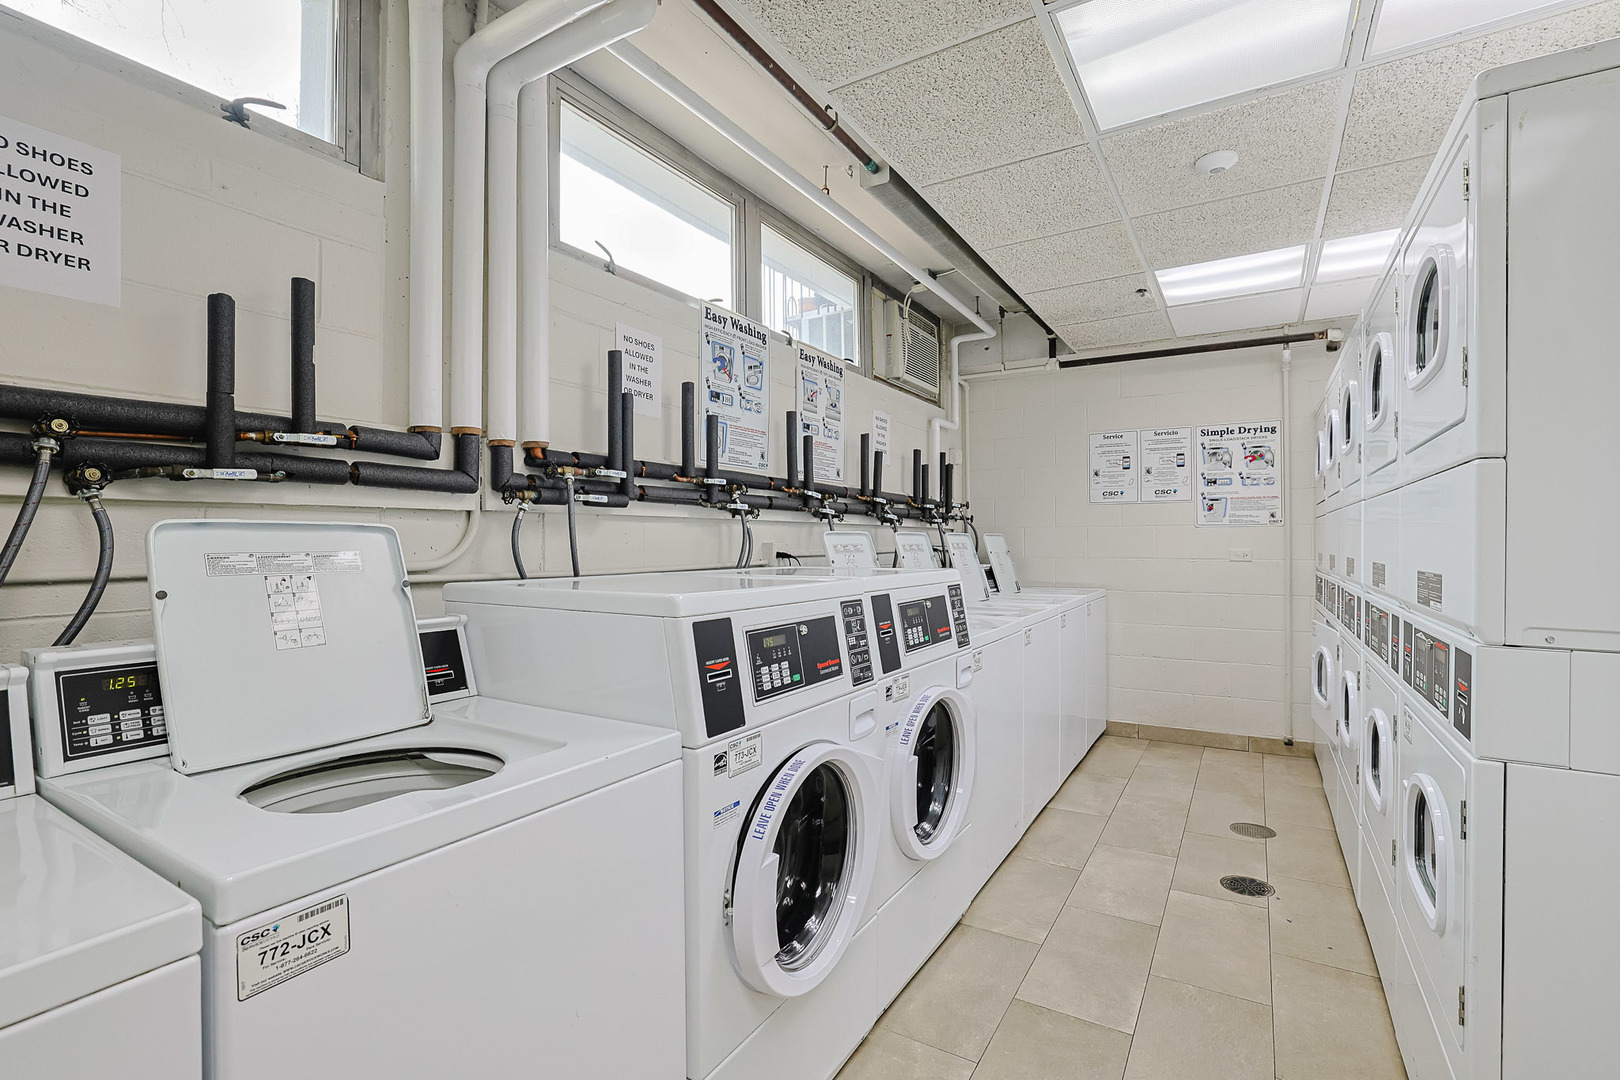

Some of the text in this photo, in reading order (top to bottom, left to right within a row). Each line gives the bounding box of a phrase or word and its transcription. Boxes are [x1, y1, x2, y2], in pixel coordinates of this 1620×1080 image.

[16, 142, 94, 175] SHOES
[28, 195, 71, 218] THE
[0, 214, 84, 245] ASHER
[17, 244, 91, 271] DRYER
[705, 306, 728, 329] Easy
[730, 316, 766, 345] Washing
[624, 335, 655, 351] NO SHOES
[625, 348, 653, 363] ALLOWED
[800, 348, 843, 378] Easy Washing
[637, 365, 648, 374] THE
[626, 374, 651, 387] WASHER
[634, 390, 654, 400] DRYER
[1200, 425, 1276, 437] Simple Drying
[110, 676, 136, 690] 1.25
[900, 727, 912, 745] LEAVE
[906, 712, 918, 728] OPEN
[734, 746, 757, 761] 773-JCX
[752, 760, 806, 840] LEAVE OPEN WHEN DONE
[240, 928, 270, 945] CSC
[257, 923, 331, 965] 772-JCX
